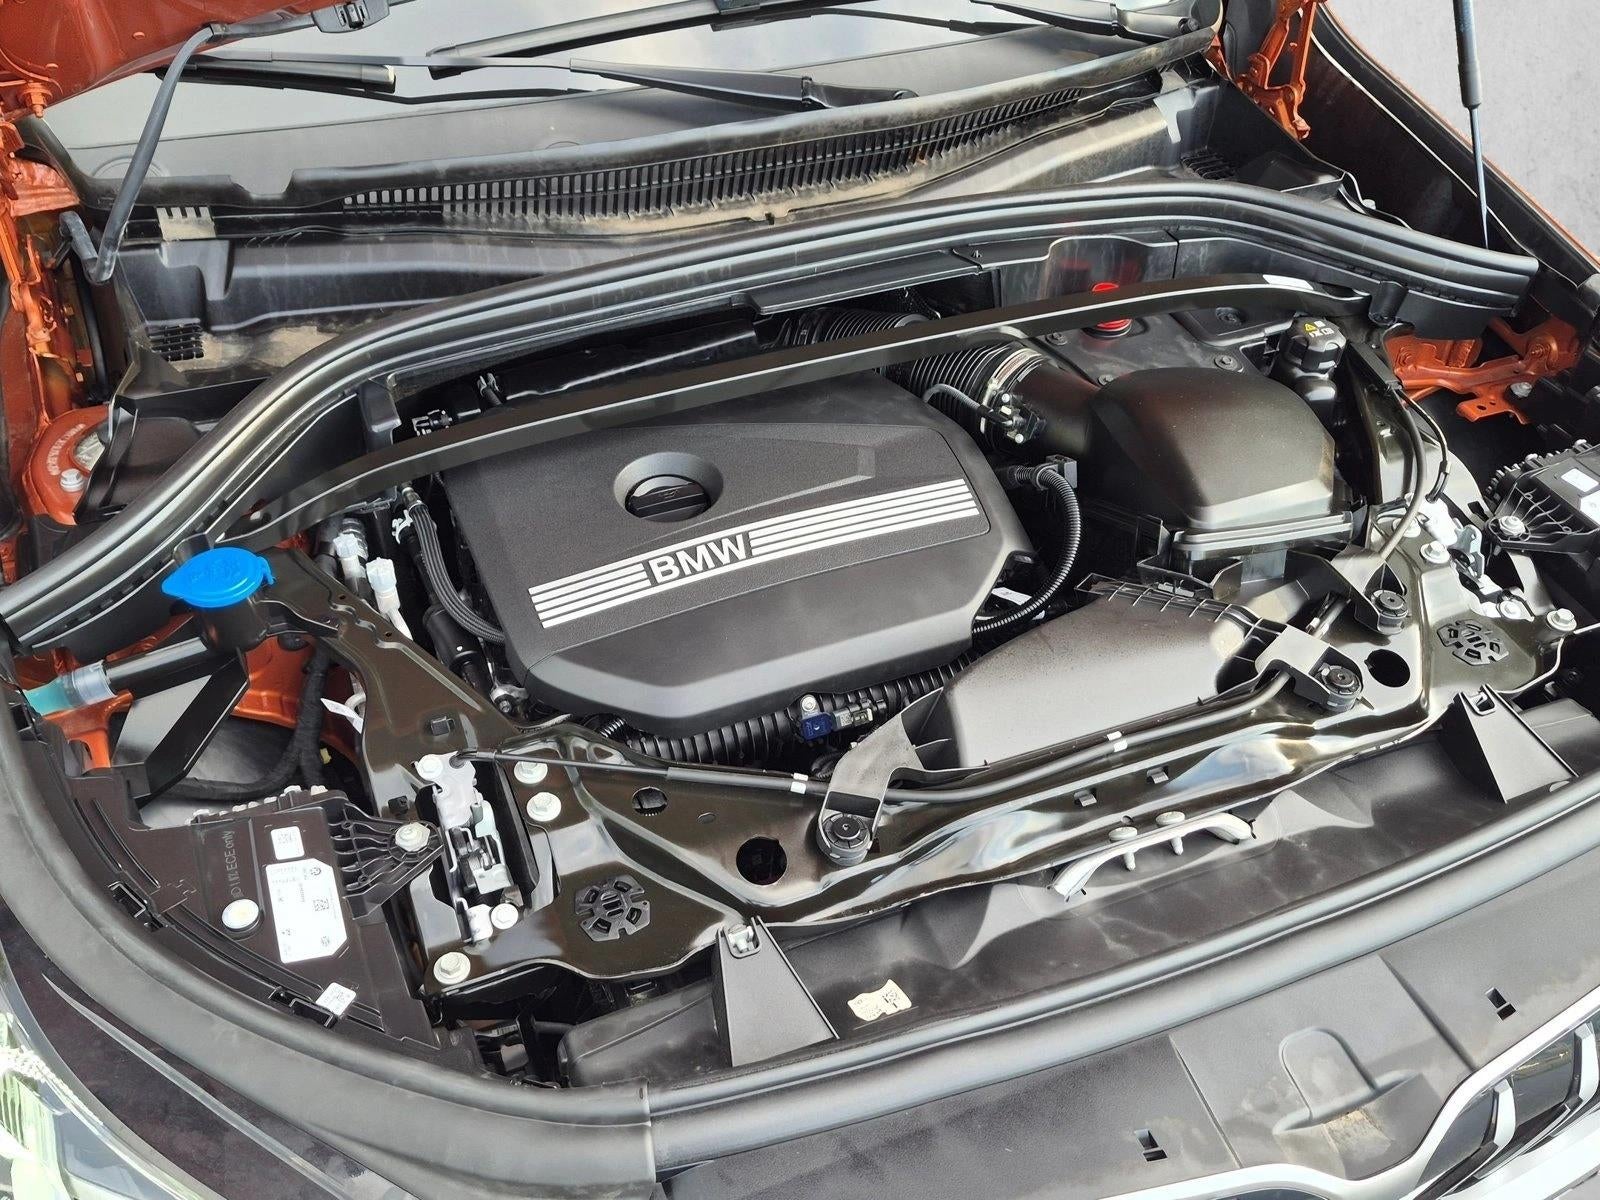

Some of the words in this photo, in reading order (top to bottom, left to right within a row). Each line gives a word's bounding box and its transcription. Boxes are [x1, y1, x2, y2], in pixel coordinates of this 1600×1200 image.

[648, 534, 746, 584] BMW
[222, 831, 235, 848] only
[225, 849, 238, 871] ECE
